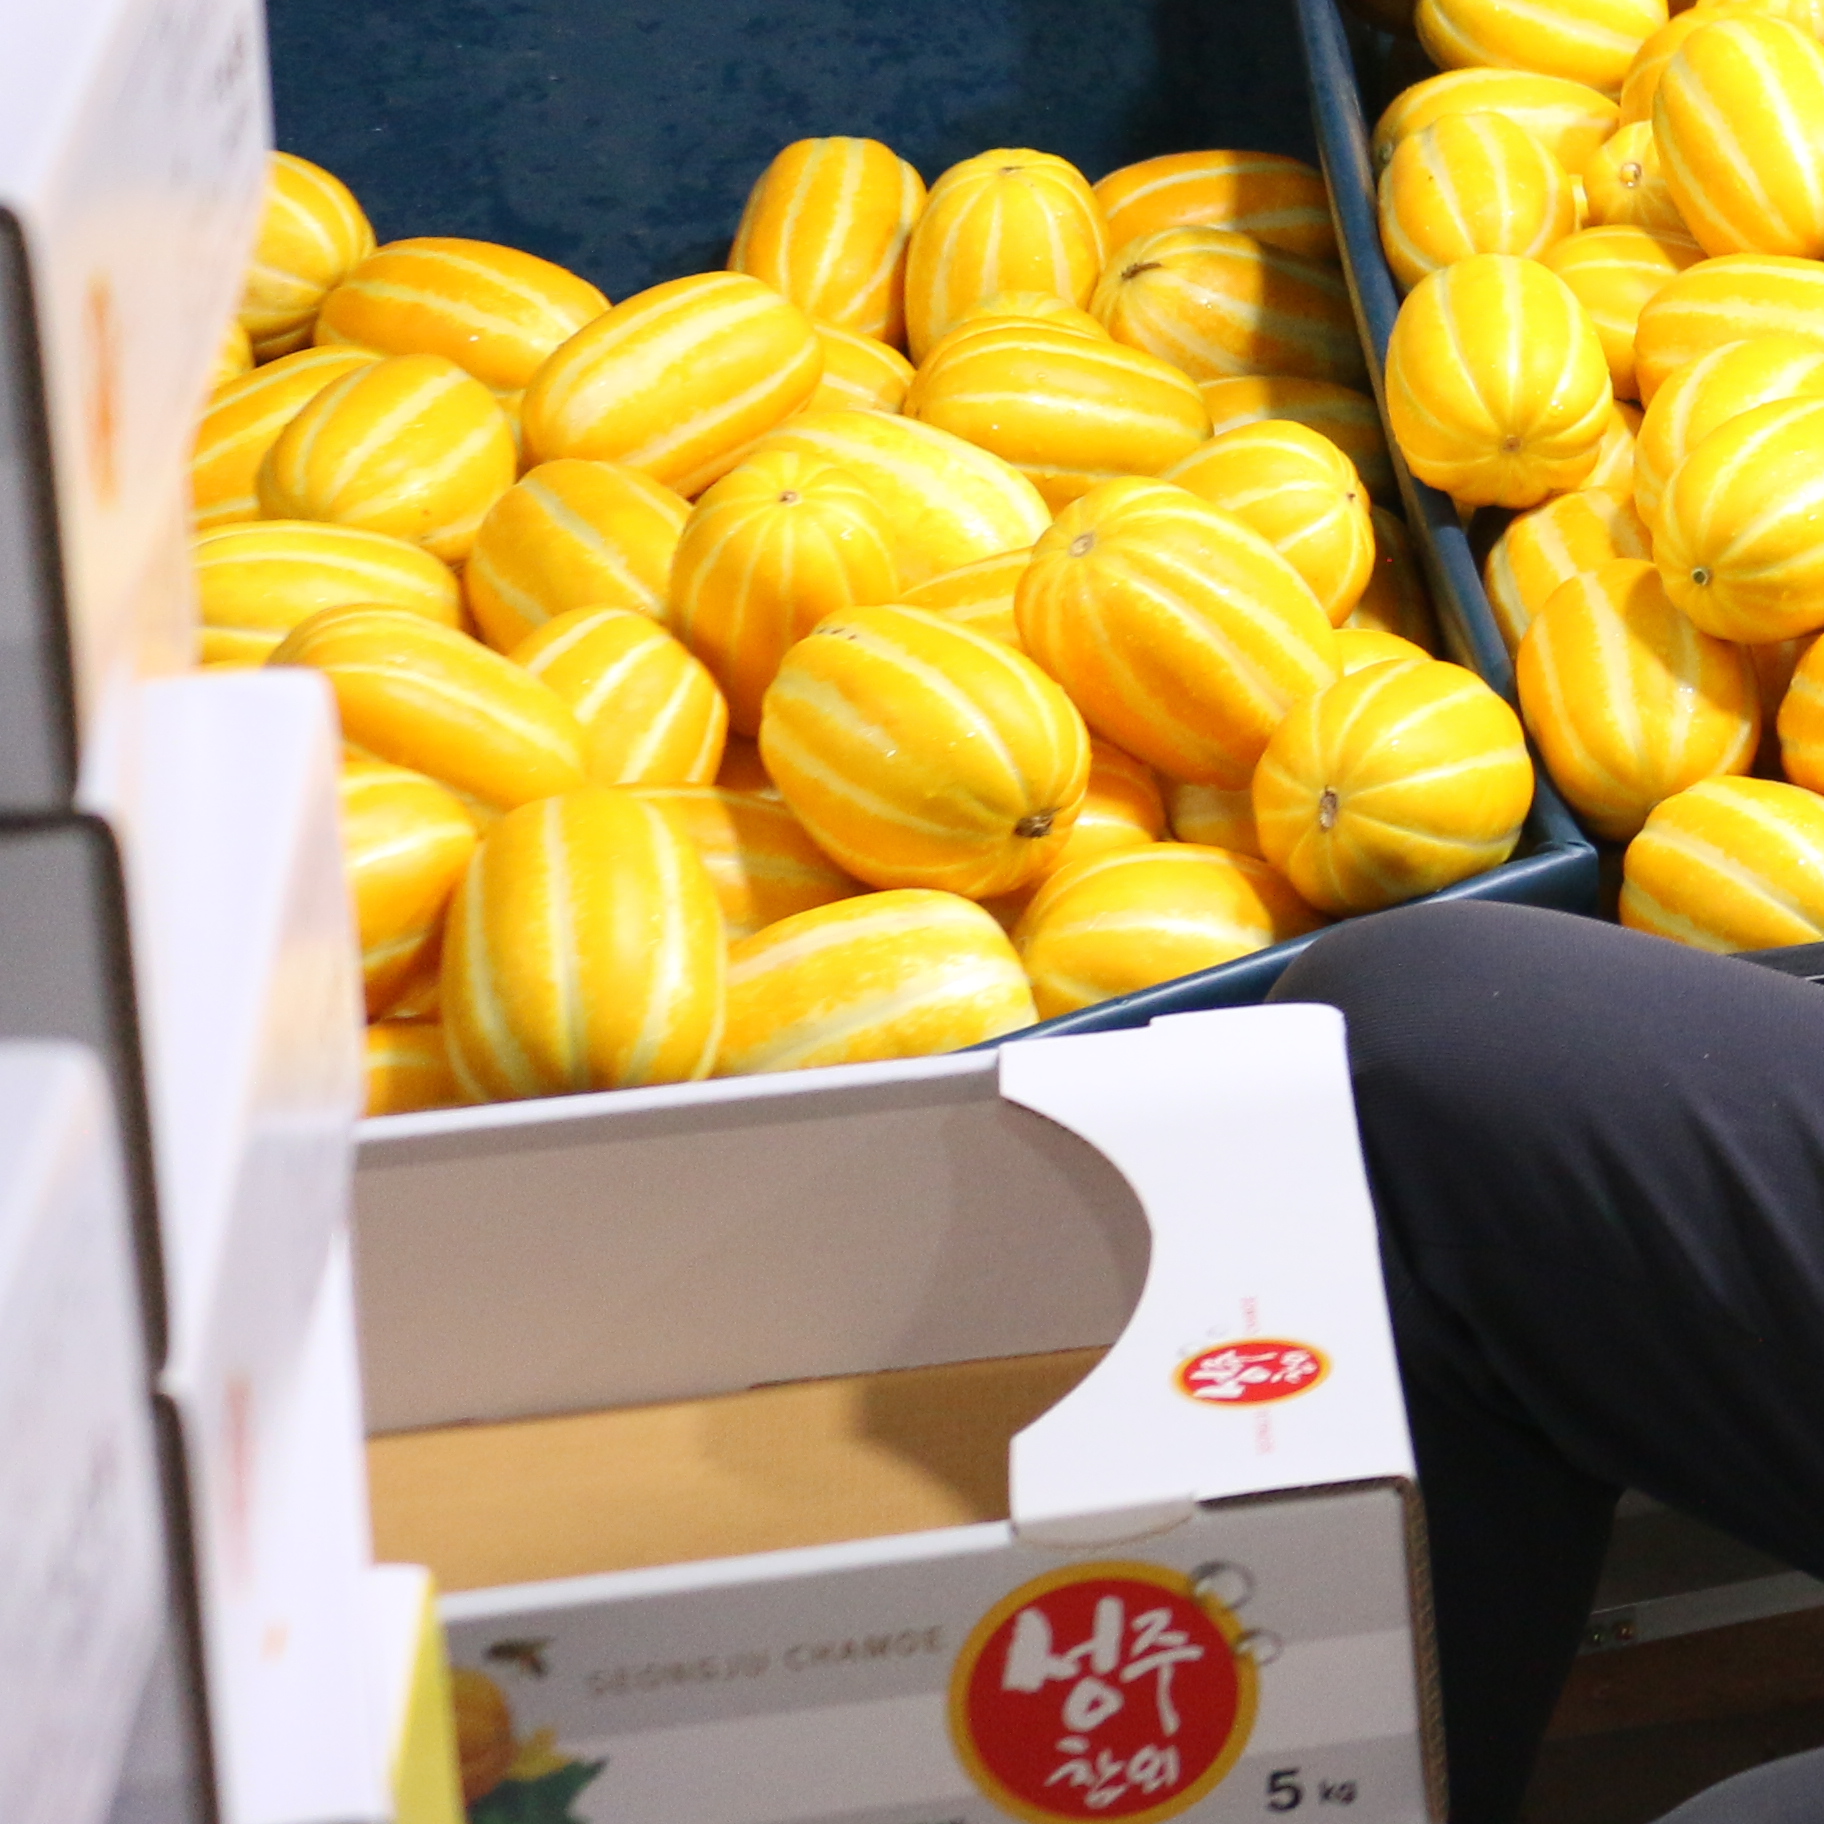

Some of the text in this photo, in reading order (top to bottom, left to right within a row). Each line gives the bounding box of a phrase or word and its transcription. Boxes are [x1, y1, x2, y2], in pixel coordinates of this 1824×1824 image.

[585, 1648, 770, 1698] SEONGJU
[1001, 1594, 1204, 1737] 성주
[1044, 1733, 1181, 1809] 참외
[1266, 1768, 1358, 1814] 5 kg
